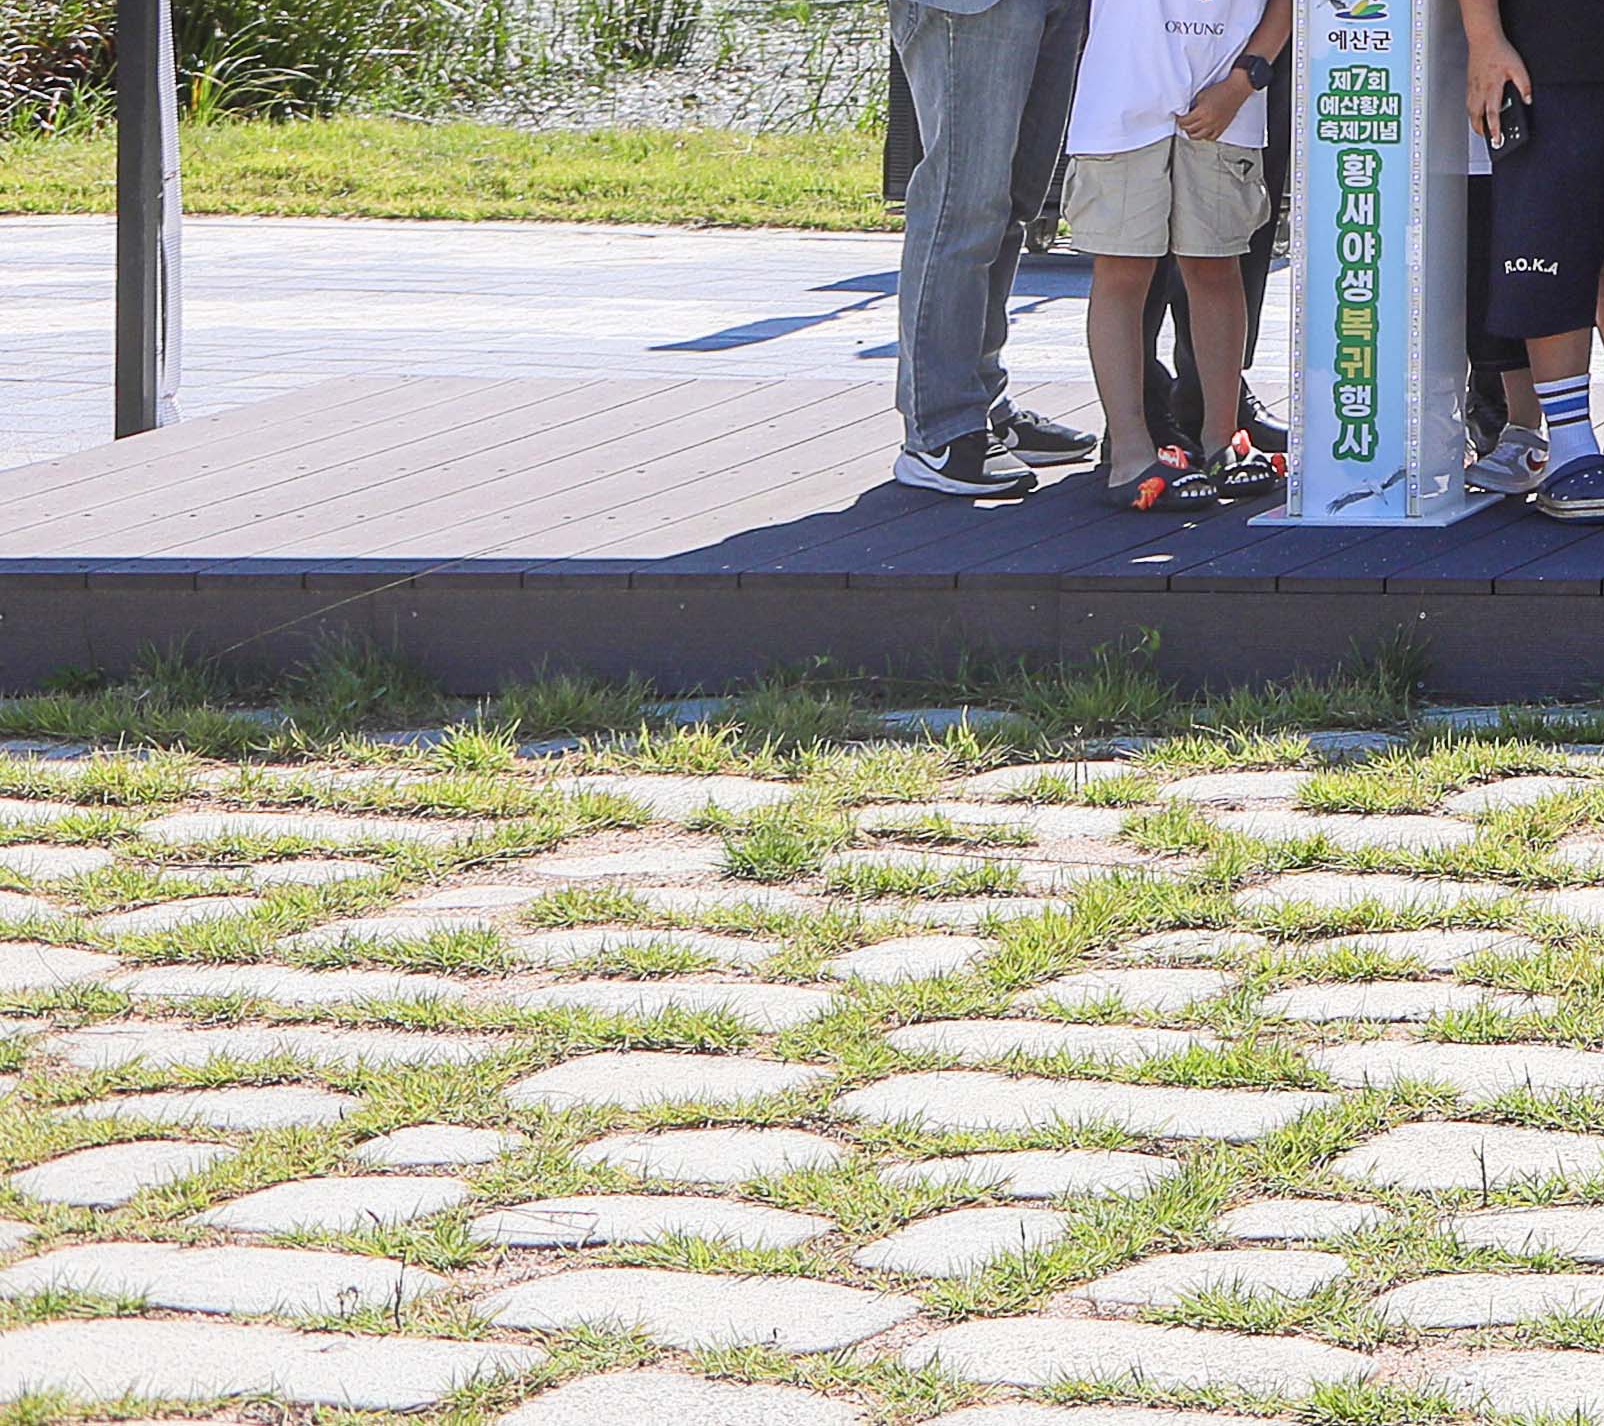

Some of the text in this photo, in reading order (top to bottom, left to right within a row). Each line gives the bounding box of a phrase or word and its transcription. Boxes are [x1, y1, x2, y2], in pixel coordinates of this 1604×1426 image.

[1327, 29, 1391, 52] 예산군
[1331, 67, 1387, 93] 제7회
[1318, 95, 1399, 118] 예산황새
[1318, 119, 1398, 142] 축제기념
